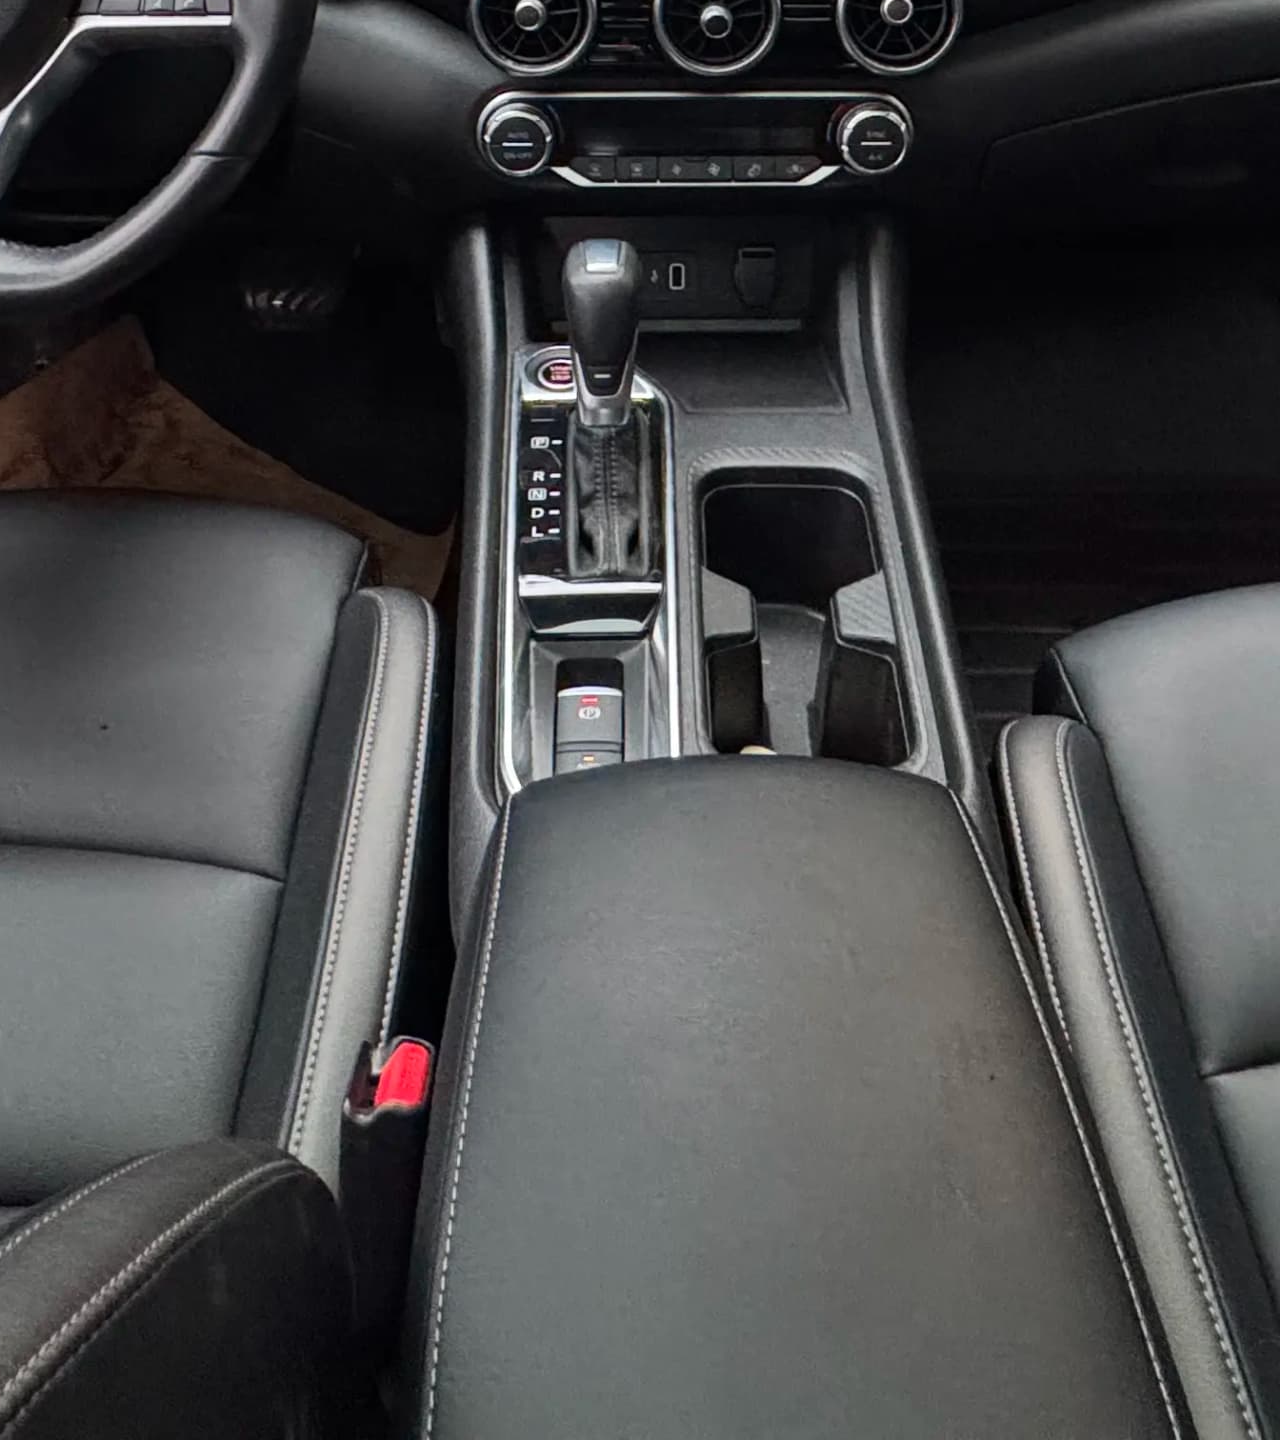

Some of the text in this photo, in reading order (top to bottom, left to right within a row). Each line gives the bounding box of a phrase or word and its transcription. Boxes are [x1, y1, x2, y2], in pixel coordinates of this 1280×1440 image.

[532, 471, 545, 482] R
[531, 508, 544, 518] D
[531, 526, 544, 537] L
